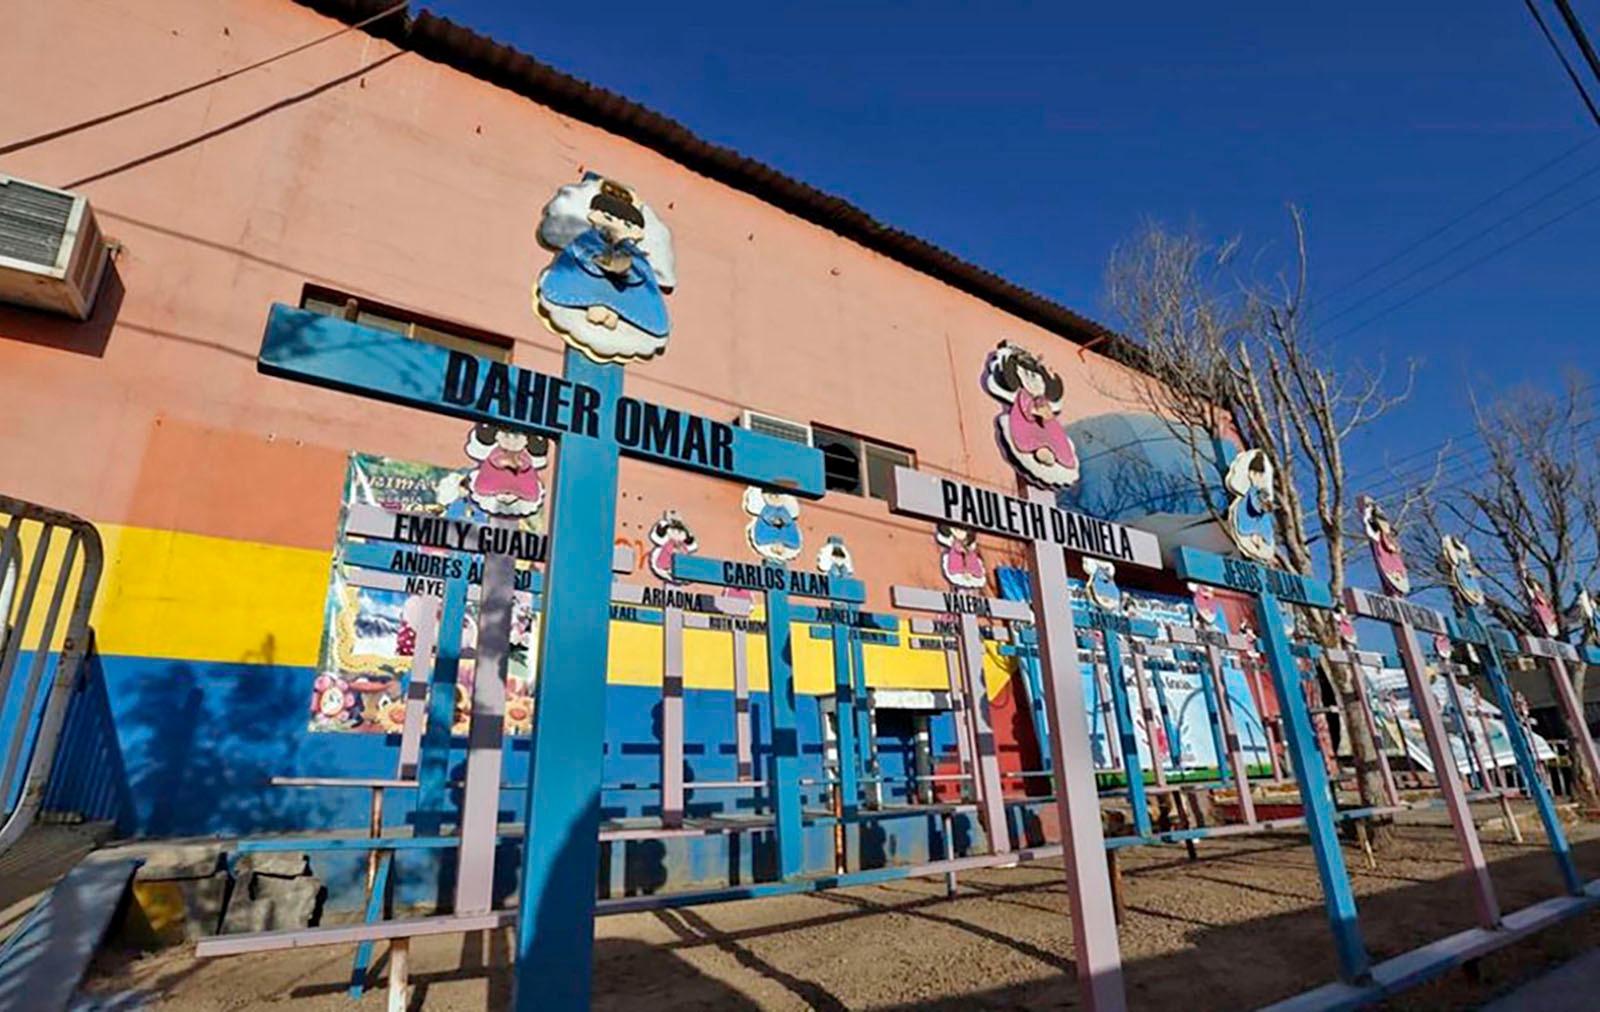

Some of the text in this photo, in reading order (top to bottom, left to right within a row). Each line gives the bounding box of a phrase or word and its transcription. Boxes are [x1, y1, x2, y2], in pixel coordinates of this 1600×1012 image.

[443, 350, 735, 470] DAHER OMAR
[394, 513, 472, 550] EMILY
[941, 479, 1135, 561] PAULETH DANIELA
[390, 550, 463, 579] ANDRES
[722, 561, 830, 596] CARLOS ALAN
[1222, 557, 1263, 592] JESUS
[404, 577, 443, 598] NAYE
[642, 587, 702, 611] ARIADNA
[943, 592, 993, 616] VALERIA
